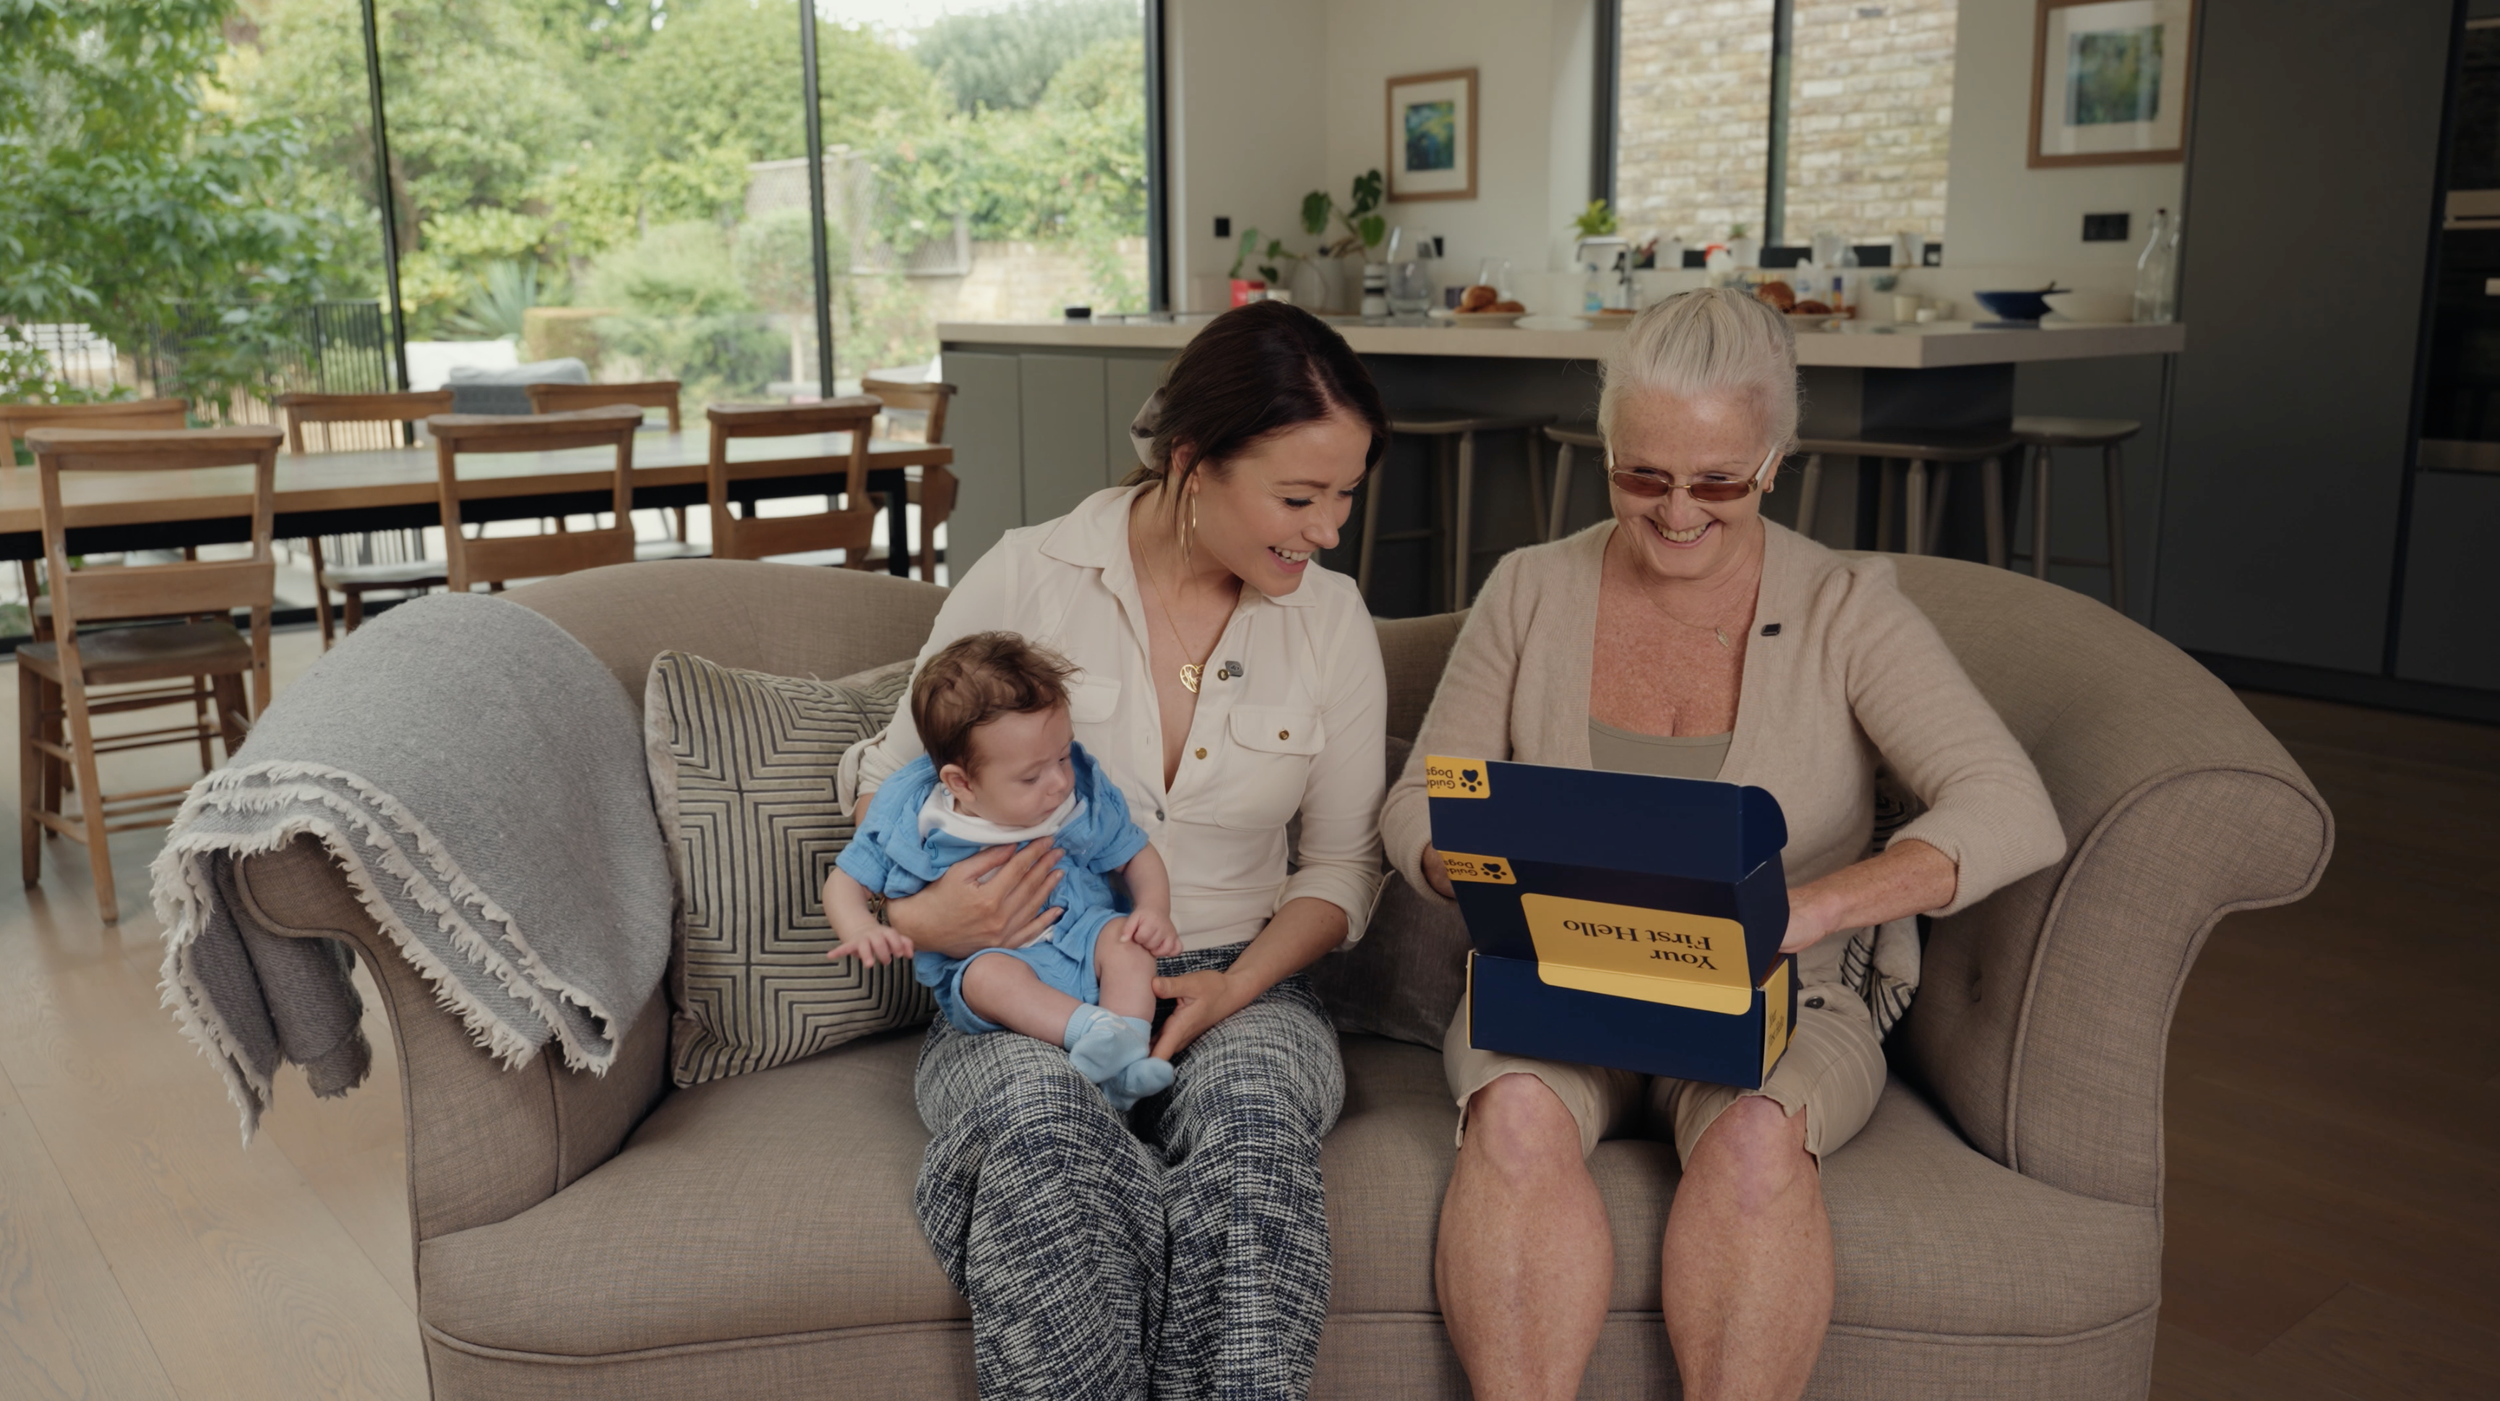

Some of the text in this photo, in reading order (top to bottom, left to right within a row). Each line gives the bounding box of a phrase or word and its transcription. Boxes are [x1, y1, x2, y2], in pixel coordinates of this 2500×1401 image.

[1426, 766, 1454, 779] Dogs
[1446, 867, 1478, 877] Guid
[1563, 919, 1713, 951] First Hello
[1650, 949, 1718, 971] Your
